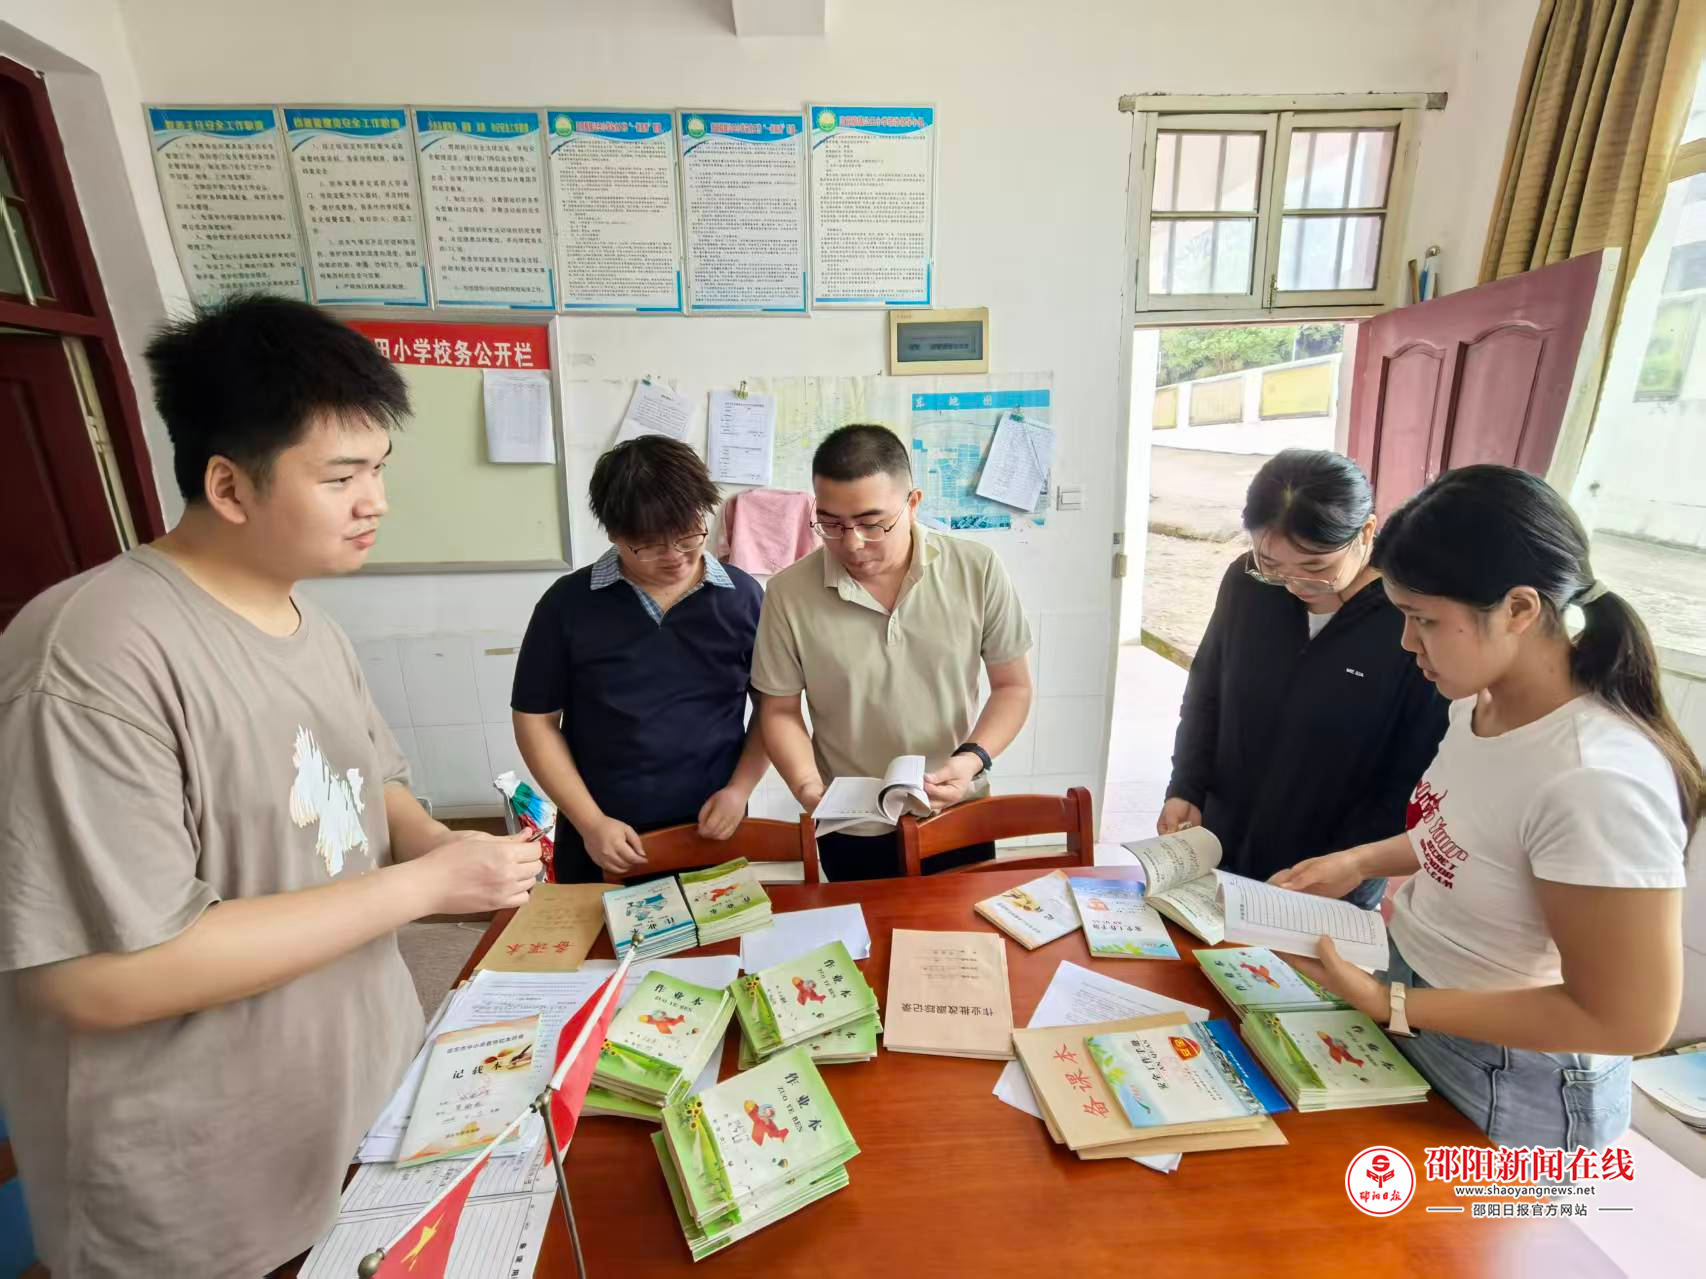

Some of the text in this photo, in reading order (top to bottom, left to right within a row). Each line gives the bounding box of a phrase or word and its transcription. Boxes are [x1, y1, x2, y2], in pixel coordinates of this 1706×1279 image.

[654, 983, 705, 1007] 作业本
[823, 958, 852, 1000] 作业本
[901, 1003, 994, 1017] 作业批改跟踪记录
[784, 1071, 824, 1132] 作业本
[1053, 1043, 1111, 1119] 备课本
